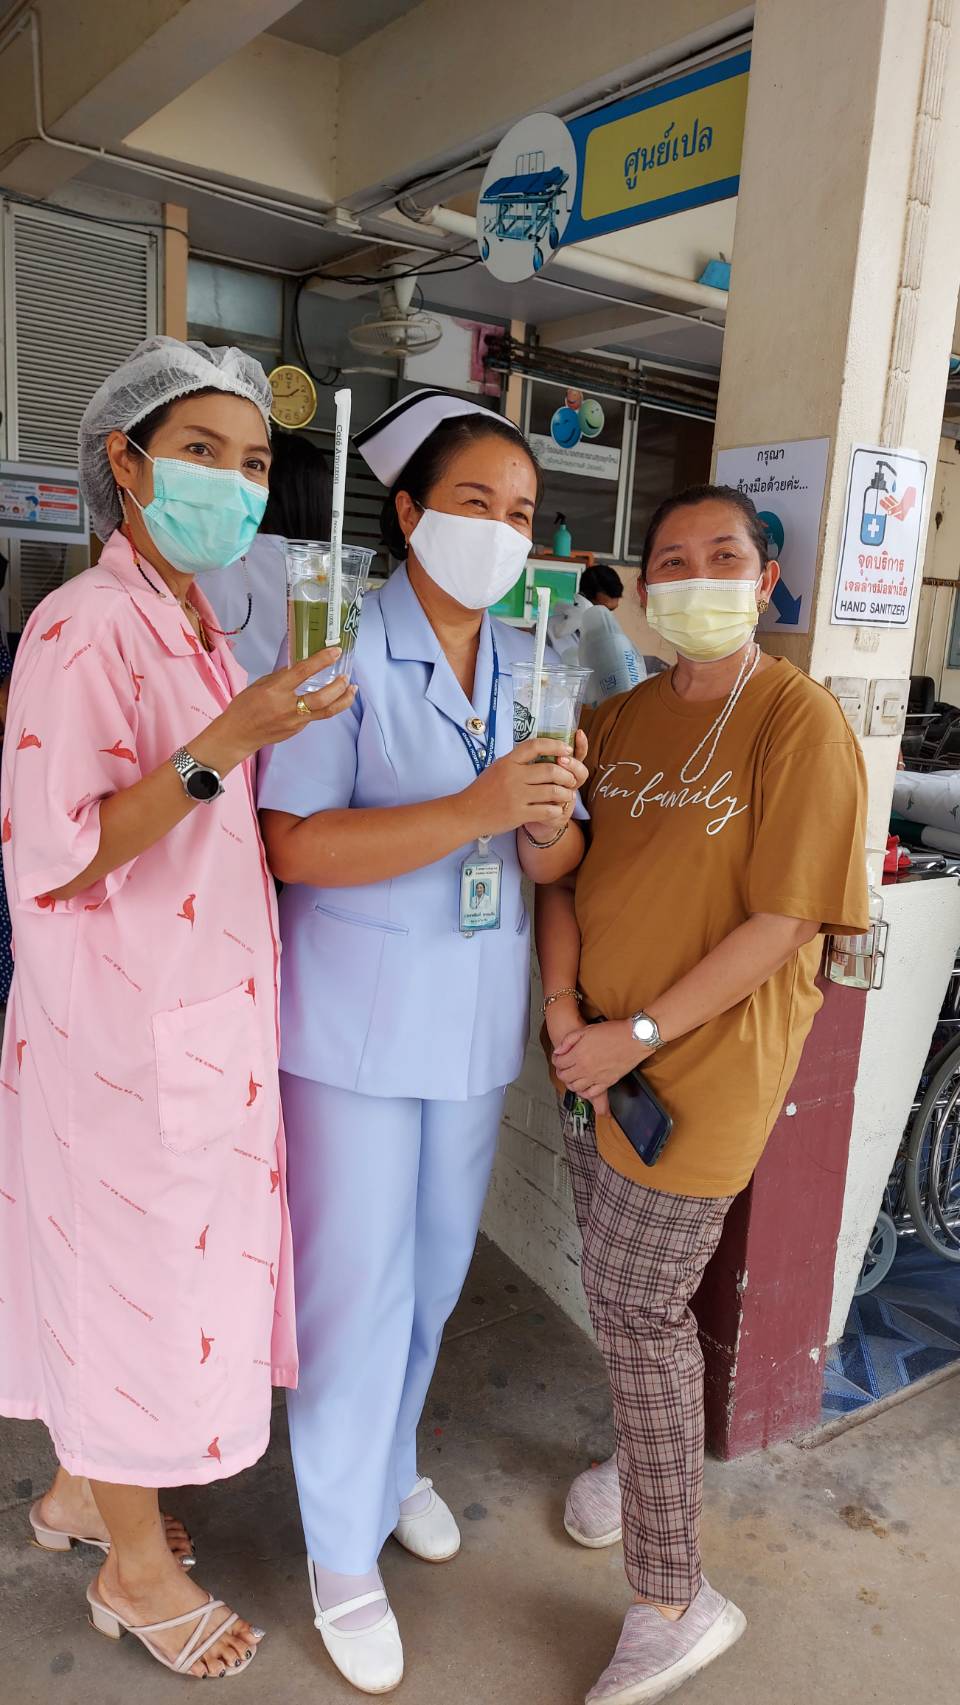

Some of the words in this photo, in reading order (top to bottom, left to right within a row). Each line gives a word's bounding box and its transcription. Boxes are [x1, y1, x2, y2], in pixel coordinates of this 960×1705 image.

[624, 118, 713, 190] ศูนย์เปล
[757, 448, 785, 467] กรุณา
[857, 550, 905, 576] จุดบริการ
[840, 600, 867, 613] HAND
[869, 602, 906, 616] SANITIZER
[591, 762, 642, 802] Tan
[630, 771, 749, 835] family
